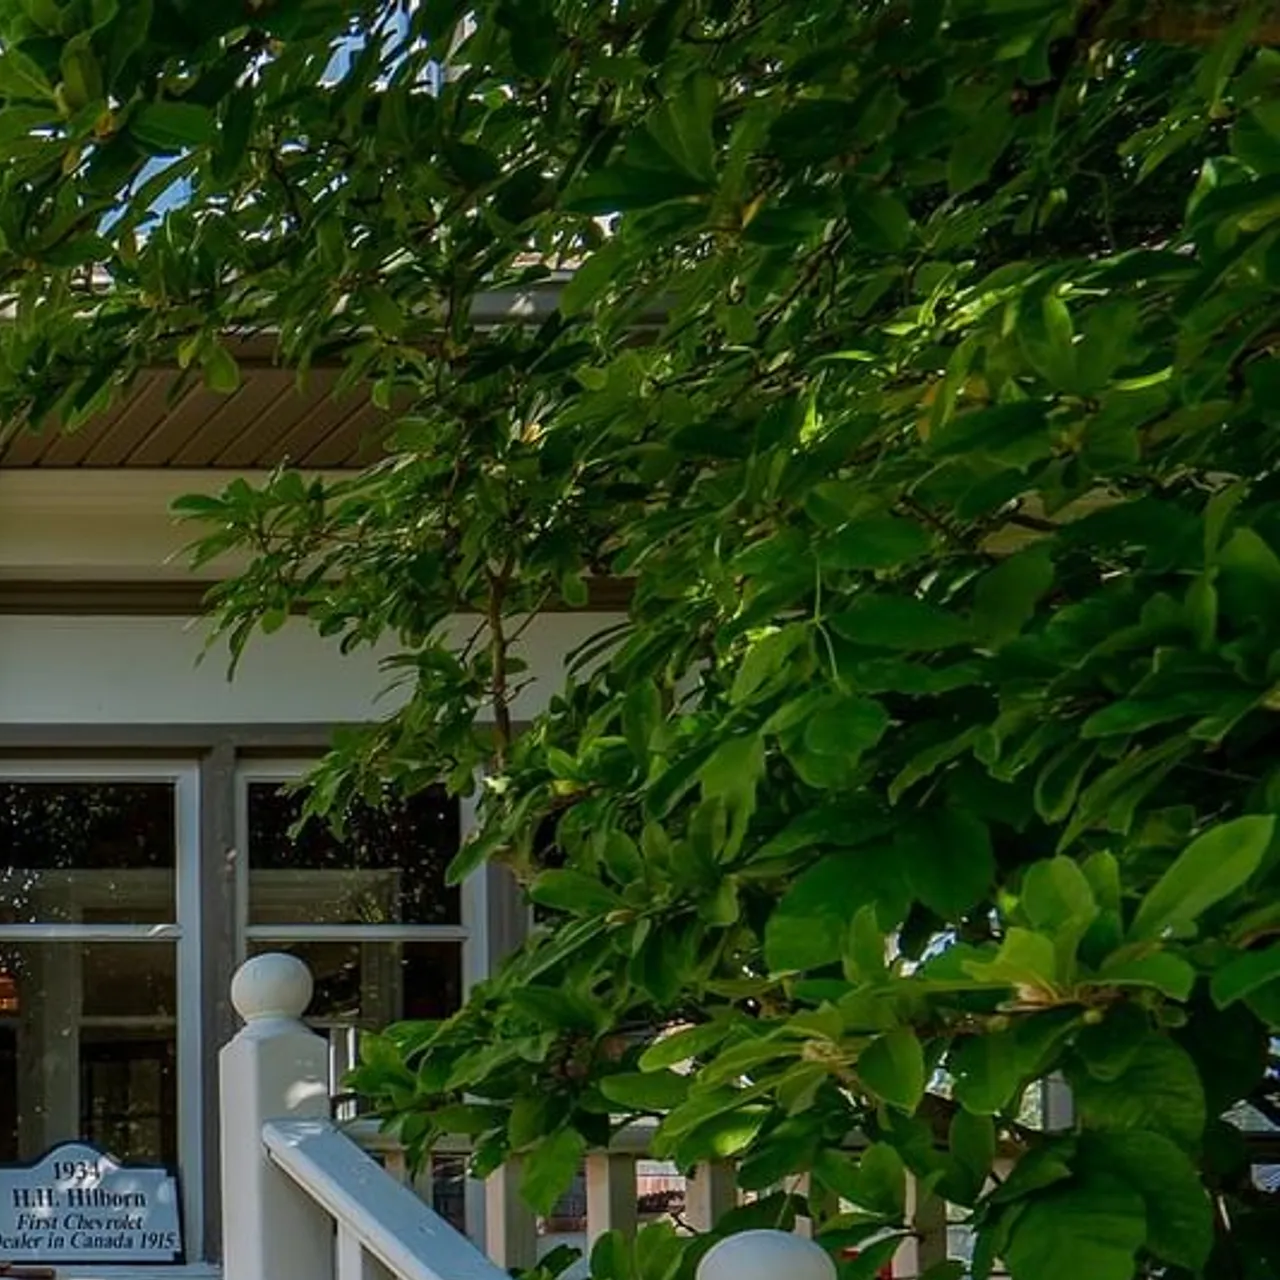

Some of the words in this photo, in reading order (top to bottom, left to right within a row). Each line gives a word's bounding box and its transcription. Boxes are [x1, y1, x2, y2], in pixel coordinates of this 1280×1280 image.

[13, 1188, 60, 1208] H.H.
[67, 1188, 147, 1208] Hilborn
[17, 1213, 58, 1230] First
[64, 1213, 142, 1231] Chevrolet
[49, 1231, 65, 1248] in
[70, 1231, 134, 1249] Canada
[140, 1231, 176, 1250] 1915
